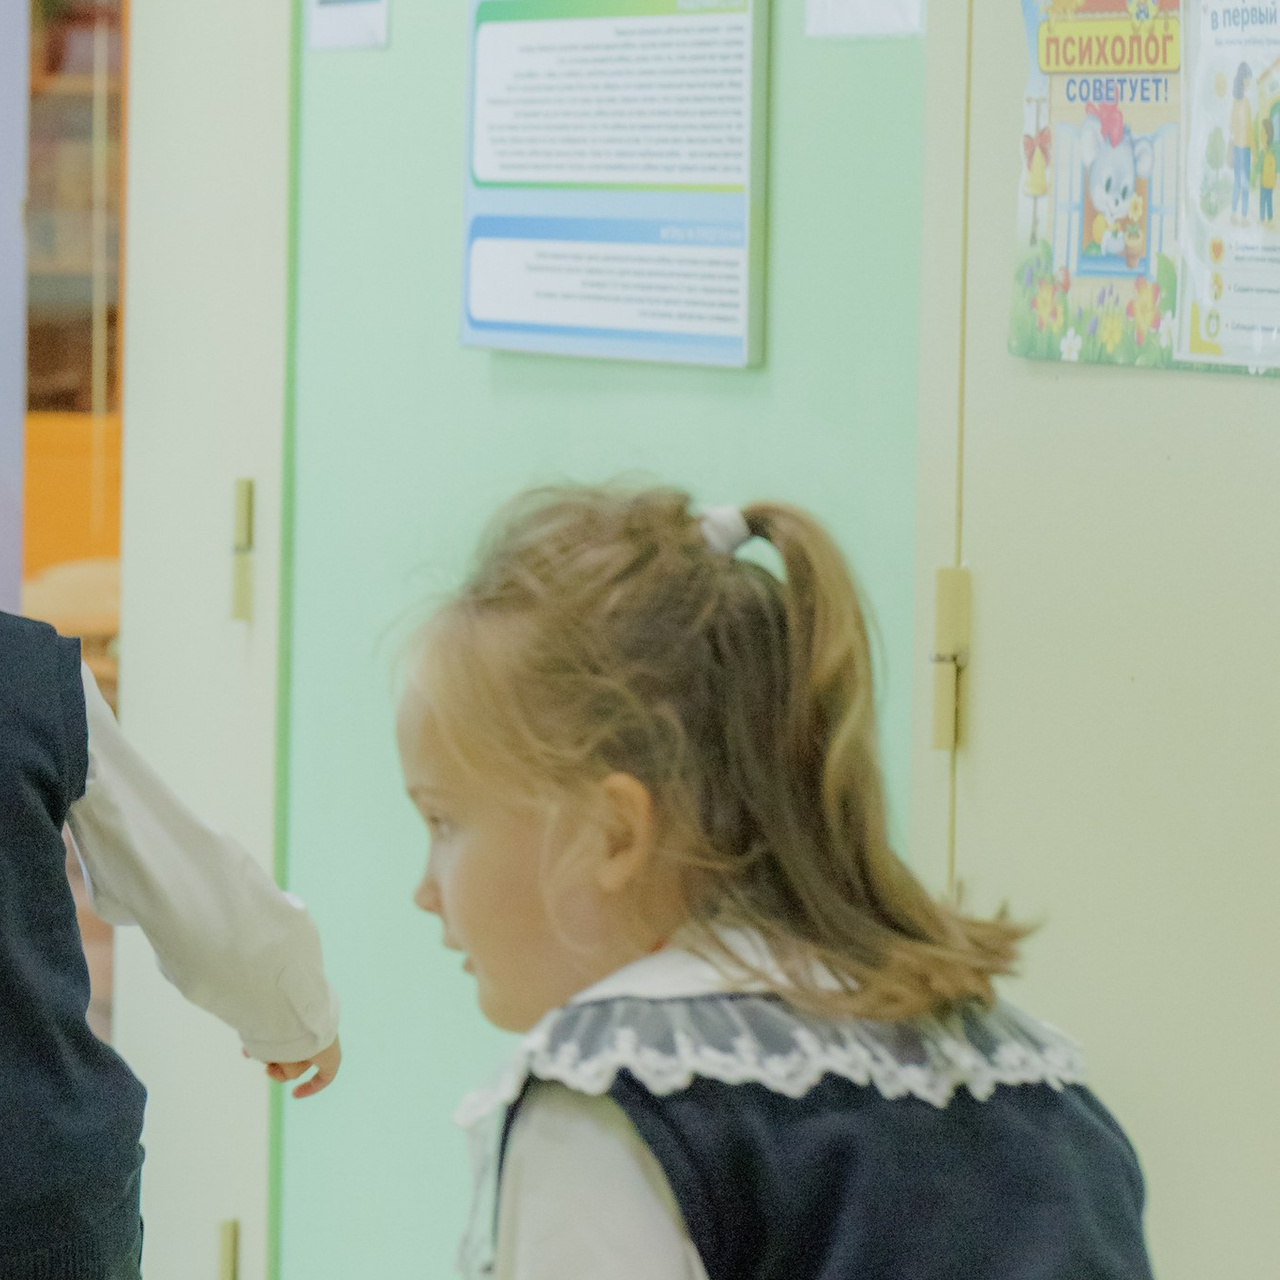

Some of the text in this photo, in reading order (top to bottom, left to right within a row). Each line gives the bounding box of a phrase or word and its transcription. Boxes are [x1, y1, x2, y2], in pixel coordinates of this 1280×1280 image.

[1211, 1, 1277, 32] в первый
[1045, 32, 1174, 67] ПСИХОЛОГ
[1066, 78, 1169, 102] СОВЕТУЕТ!
